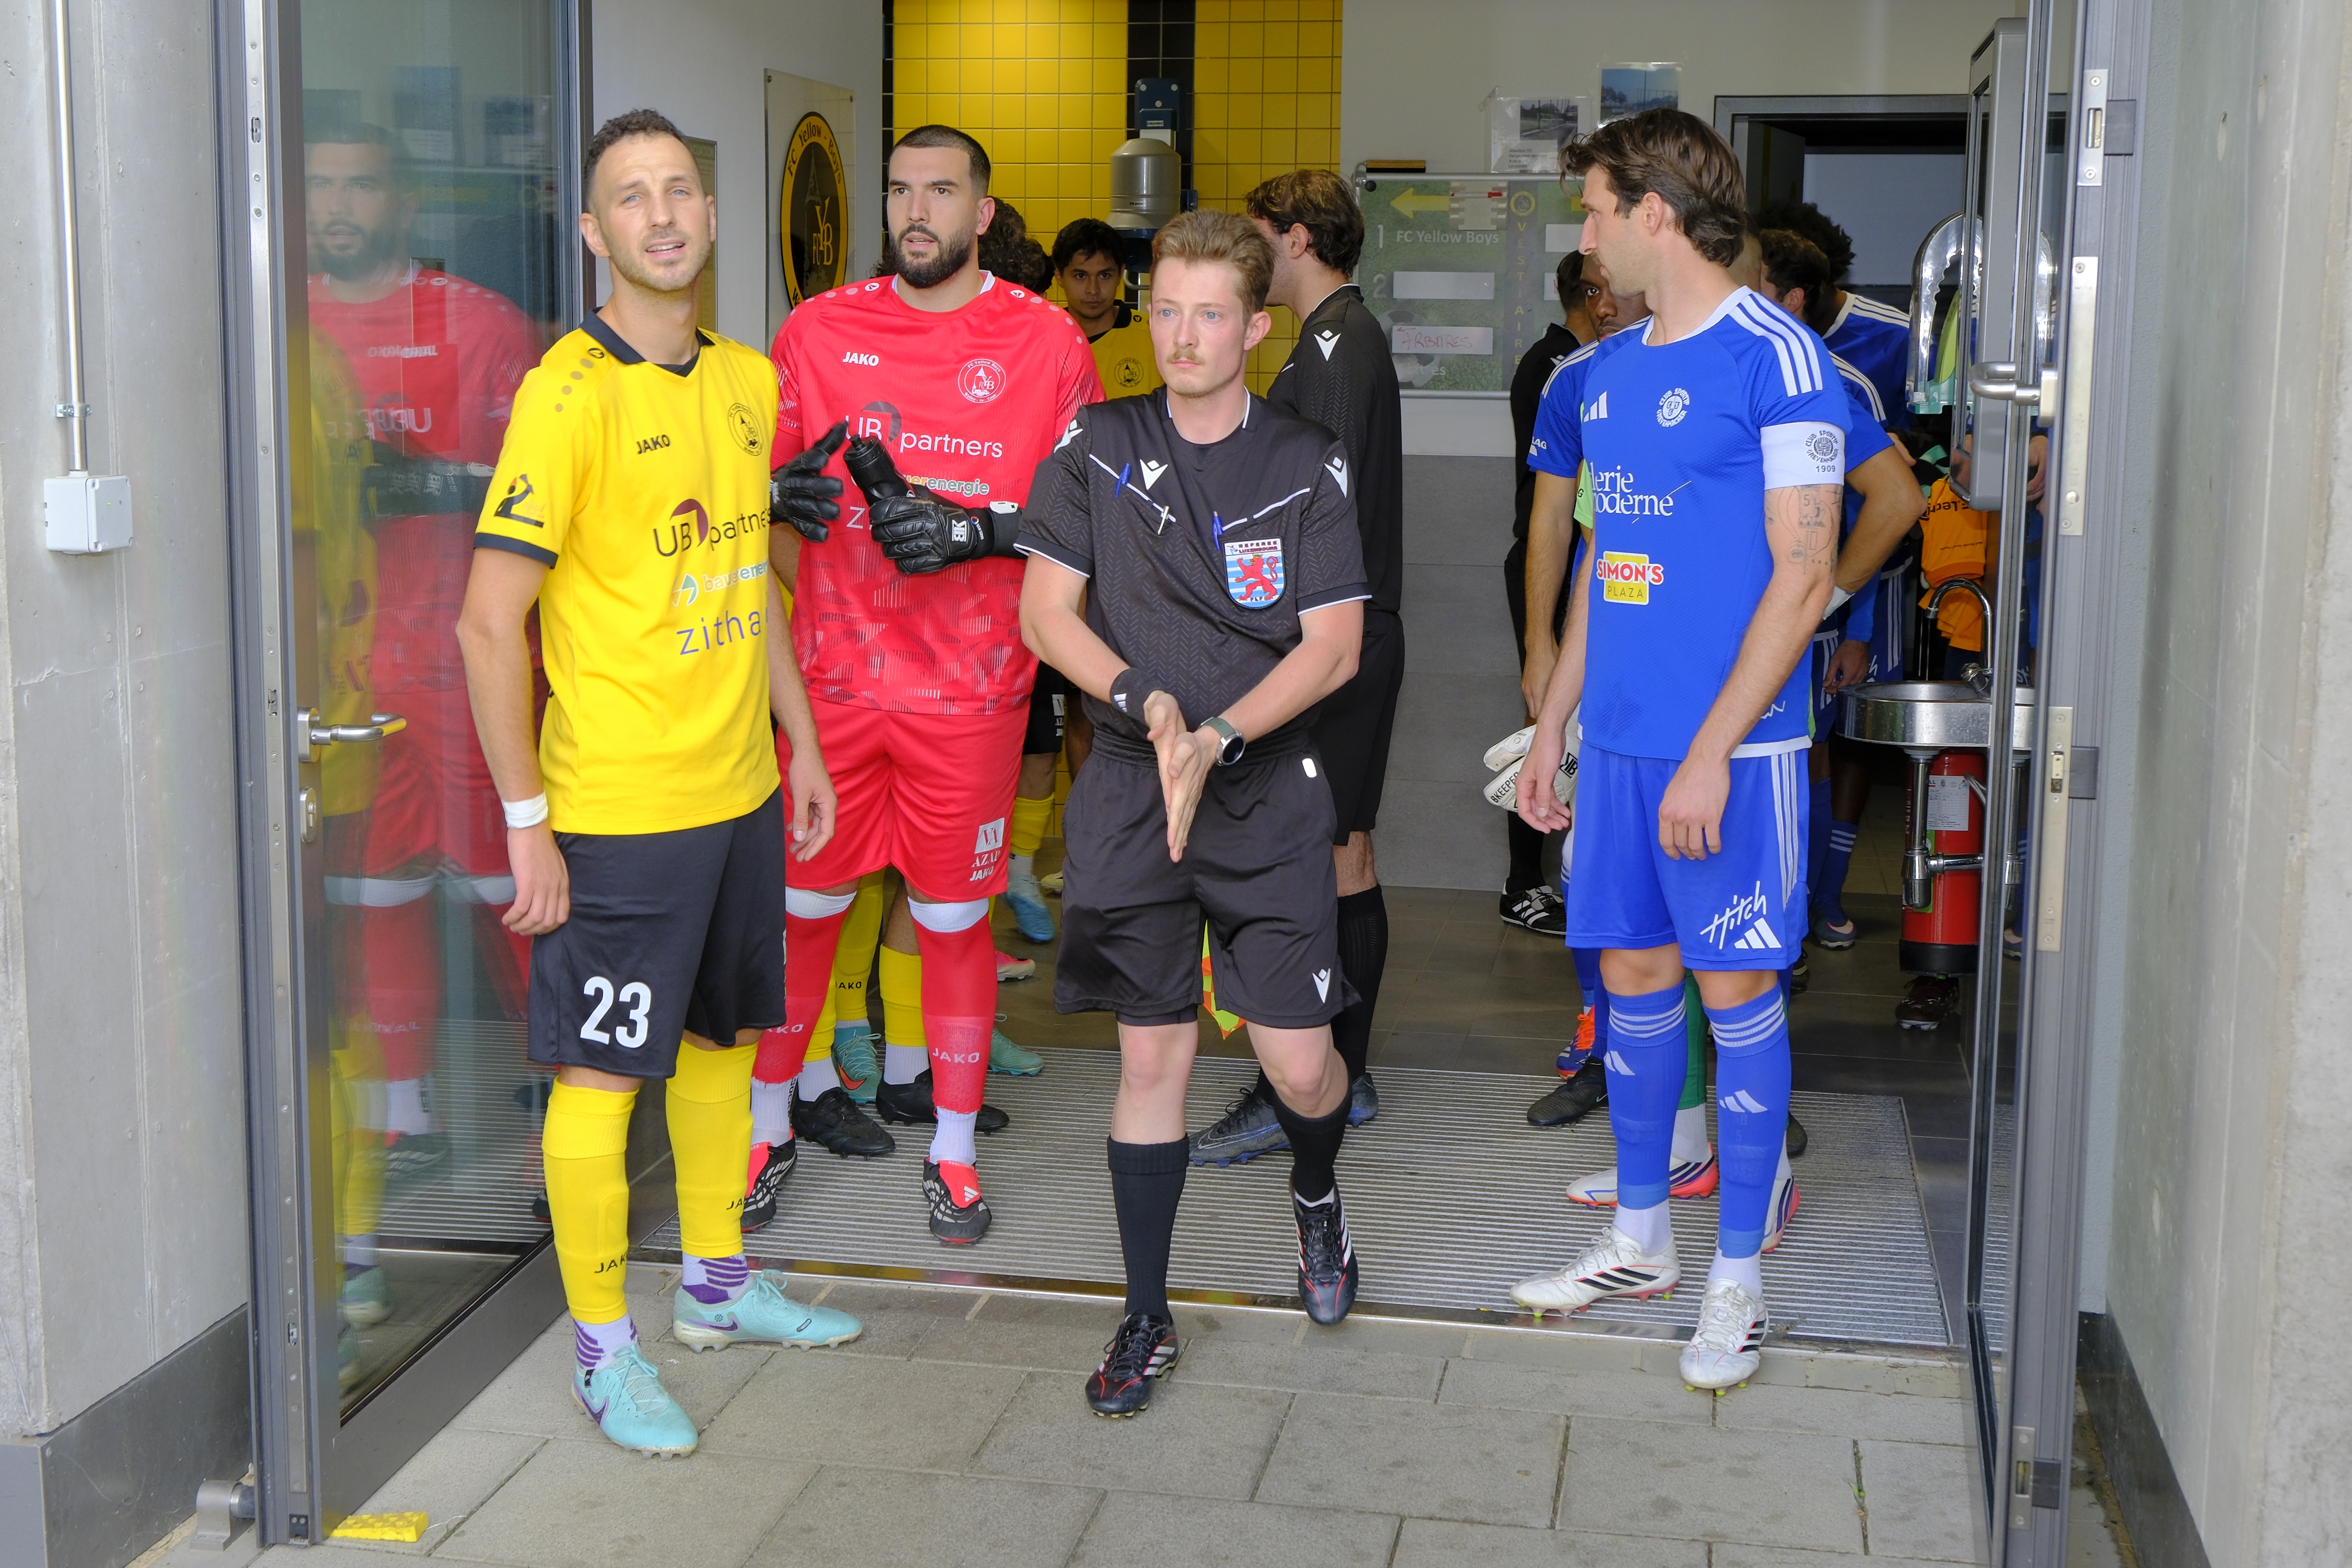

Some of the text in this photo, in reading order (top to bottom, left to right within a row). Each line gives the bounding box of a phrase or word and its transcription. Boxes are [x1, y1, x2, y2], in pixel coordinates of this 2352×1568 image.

[788, 148, 797, 177] FC
[798, 122, 822, 147] Yellow
[828, 137, 841, 184] Boys
[1377, 225, 1384, 248] 1
[1397, 230, 1499, 246] FC Yellow Boys
[1373, 274, 1386, 298] 2
[843, 351, 879, 366] JAKO
[991, 363, 1002, 372] Boys
[1673, 387, 1690, 406] SPORTIF
[637, 434, 671, 454] JAKO
[900, 432, 1003, 458] partners
[1805, 430, 1838, 447] CLUB SPORTIF
[1804, 494, 1810, 506] 5
[653, 522, 692, 557] UB
[1598, 561, 1662, 583] SIMON'S
[1608, 586, 1643, 598] PLAZA
[971, 850, 1001, 868] AZAP
[970, 865, 994, 881] JAKO
[1700, 881, 1766, 949] Hitch
[580, 976, 651, 1048] 23
[932, 1047, 980, 1064] JAKO
